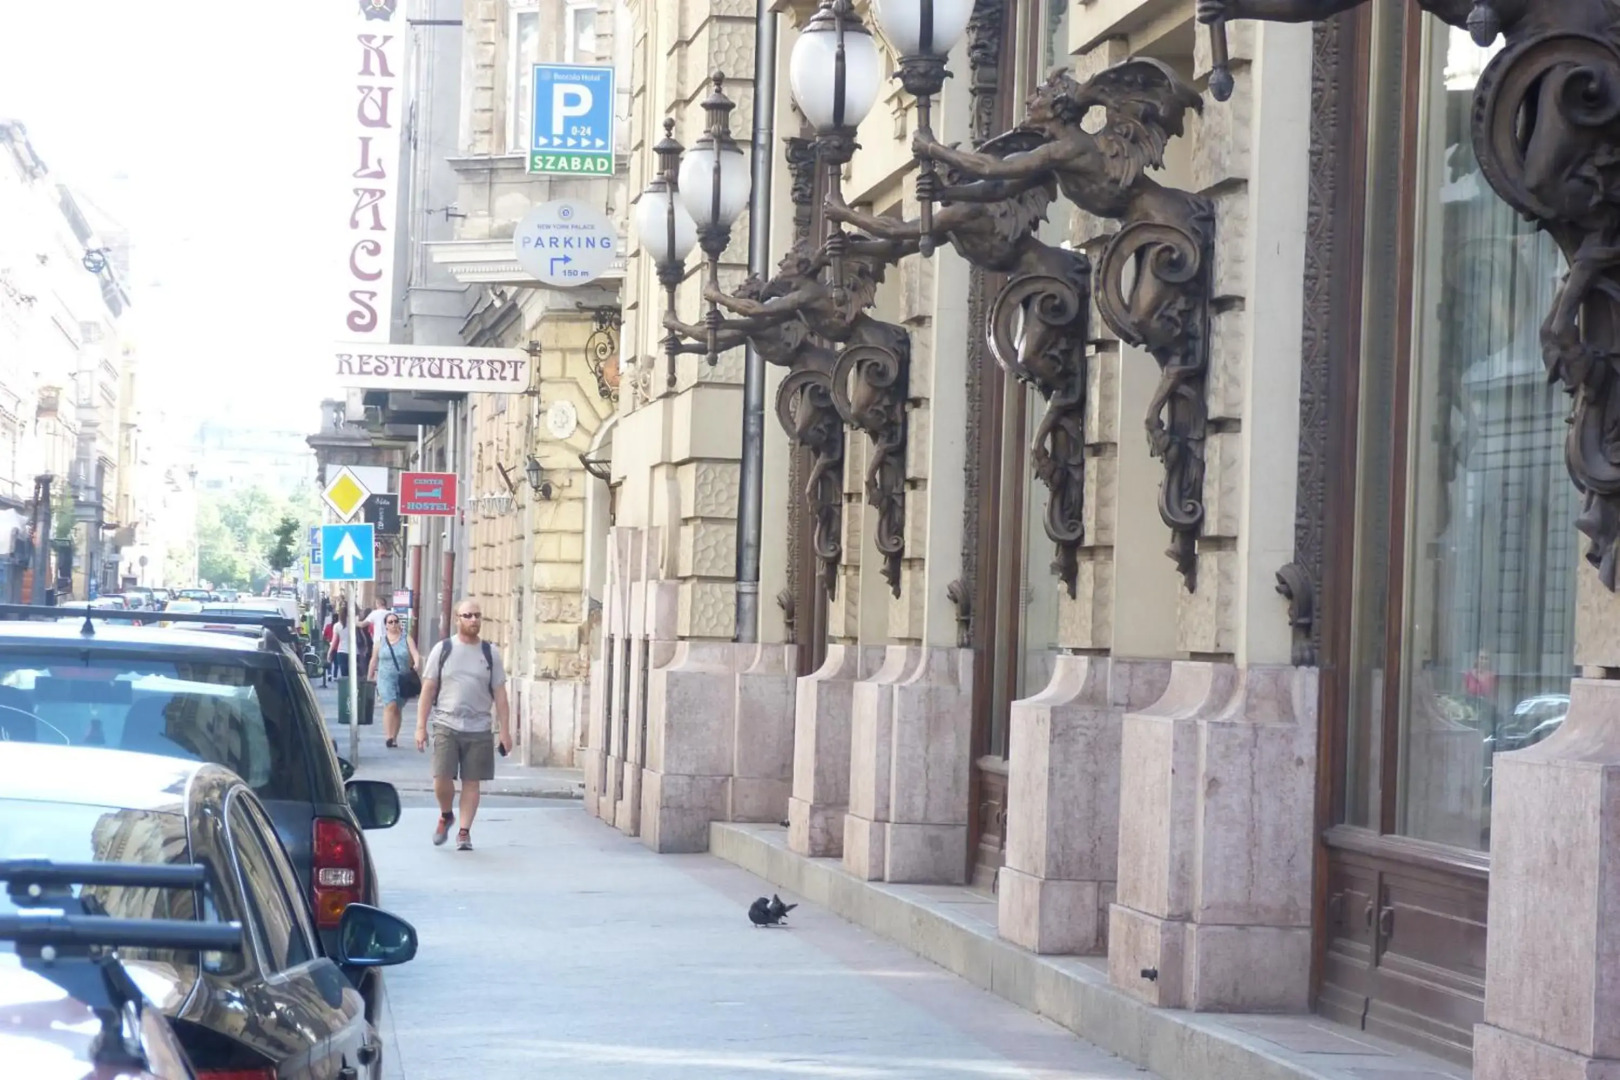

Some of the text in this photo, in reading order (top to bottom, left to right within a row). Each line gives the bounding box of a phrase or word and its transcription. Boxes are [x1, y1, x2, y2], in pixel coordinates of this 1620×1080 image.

[552, 83, 593, 135] P
[571, 125, 592, 136] 0-24
[534, 155, 609, 172] SZABAD
[346, 34, 396, 333] KULACS
[522, 236, 611, 249] PARKING
[562, 269, 579, 277] 150
[335, 353, 526, 382] RESTAURANT
[407, 502, 449, 511] HOSTEL
